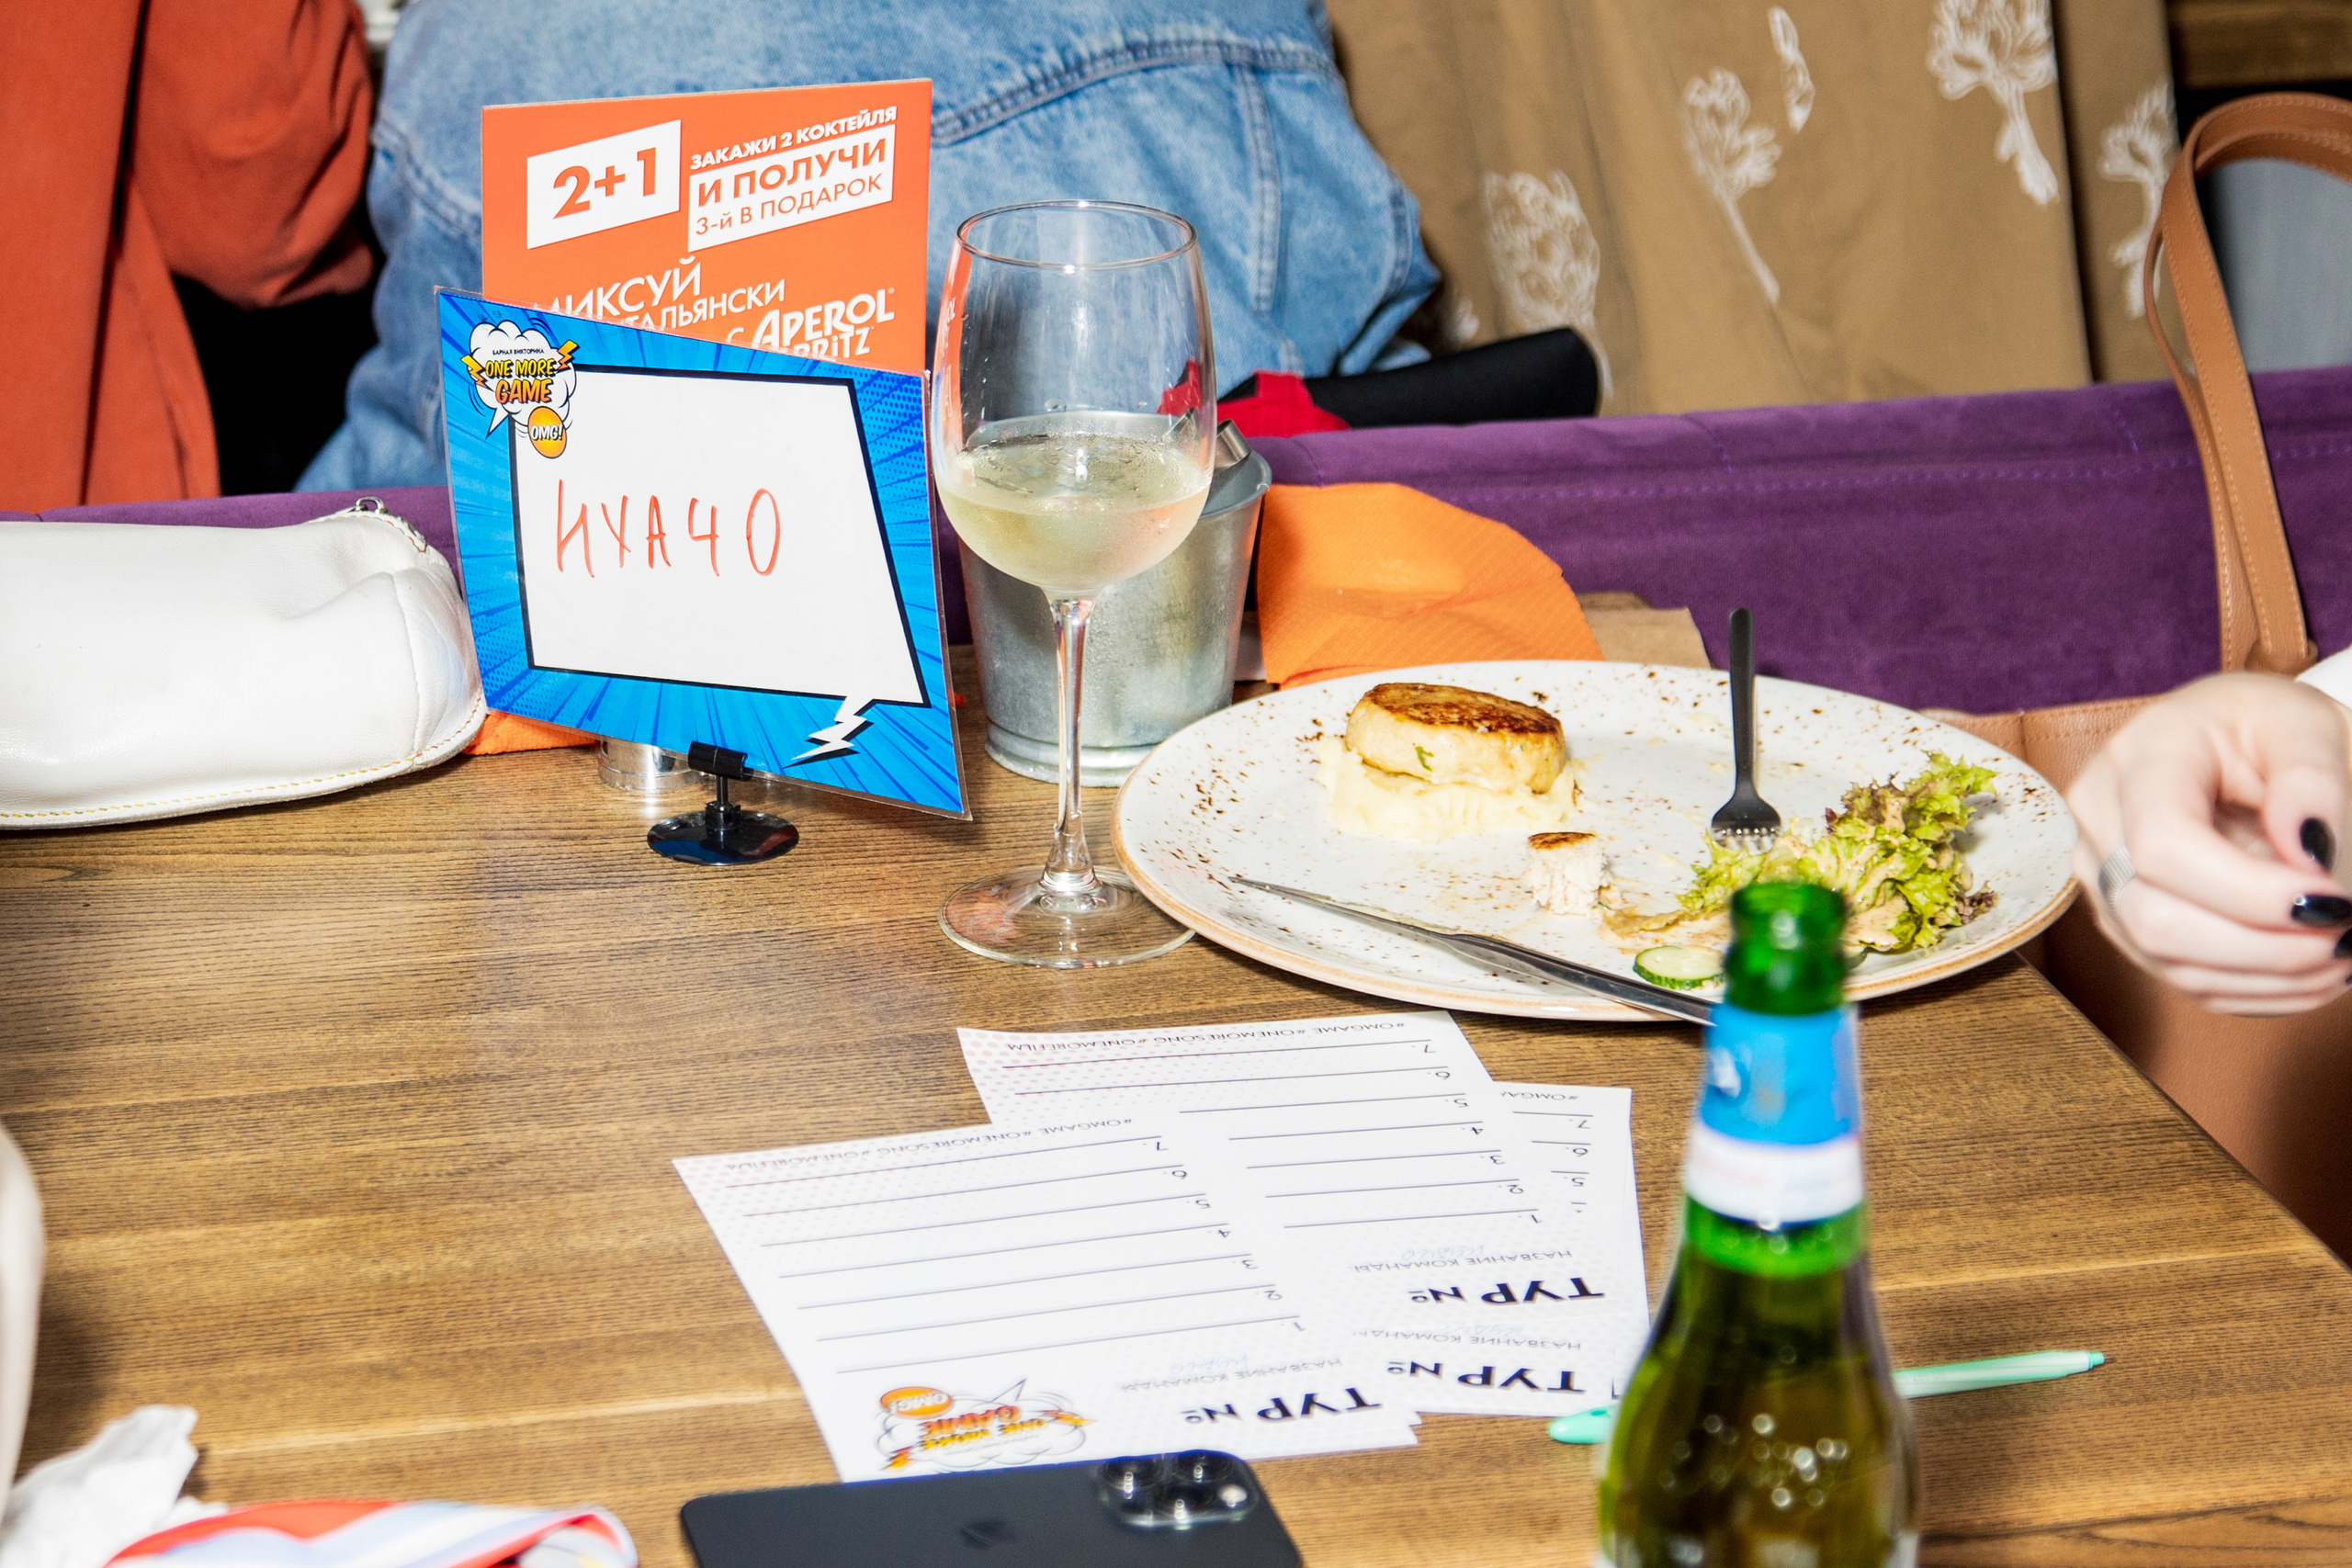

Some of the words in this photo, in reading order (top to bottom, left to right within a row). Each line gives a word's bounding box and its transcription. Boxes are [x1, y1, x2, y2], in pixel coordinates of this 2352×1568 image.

[689, 135, 777, 170] ЗАКАЖИ
[780, 131, 793, 149] 2
[797, 106, 898, 144] КОКТЕЙЛЯ
[552, 146, 657, 220] 2+1
[697, 178, 722, 208] И
[733, 138, 887, 199] ПОЛУЧИ
[695, 211, 733, 236] 3-й
[741, 206, 752, 225] В
[760, 173, 883, 220] ПОДАРОК
[751, 288, 896, 351] APEROL
[485, 359, 514, 378] ONE
[515, 358, 556, 378] MORE
[495, 378, 554, 404] GAME
[530, 424, 563, 441] OMG!
[1154, 1028, 1306, 1044] #ONEMORESONG
[1312, 1021, 1406, 1034] #OMGAME
[1007, 1038, 1147, 1052] #ONEMOREFILM
[1039, 1118, 1133, 1135] #OMGAME
[876, 1131, 1032, 1156] #ONEMORESONG
[1467, 1250, 1573, 1266] НАЗВАНИЕ
[1408, 1286, 1468, 1303] №
[1481, 1277, 1606, 1304] ТУР
[1469, 1335, 1581, 1350] НАЗВАНИЕ
[1237, 1358, 1342, 1379] НАЗВАНИЕ
[1386, 1360, 1443, 1378] №
[1457, 1365, 1587, 1393] ТУР
[1257, 1387, 1383, 1420] ТУР
[1181, 1404, 1241, 1424] №
